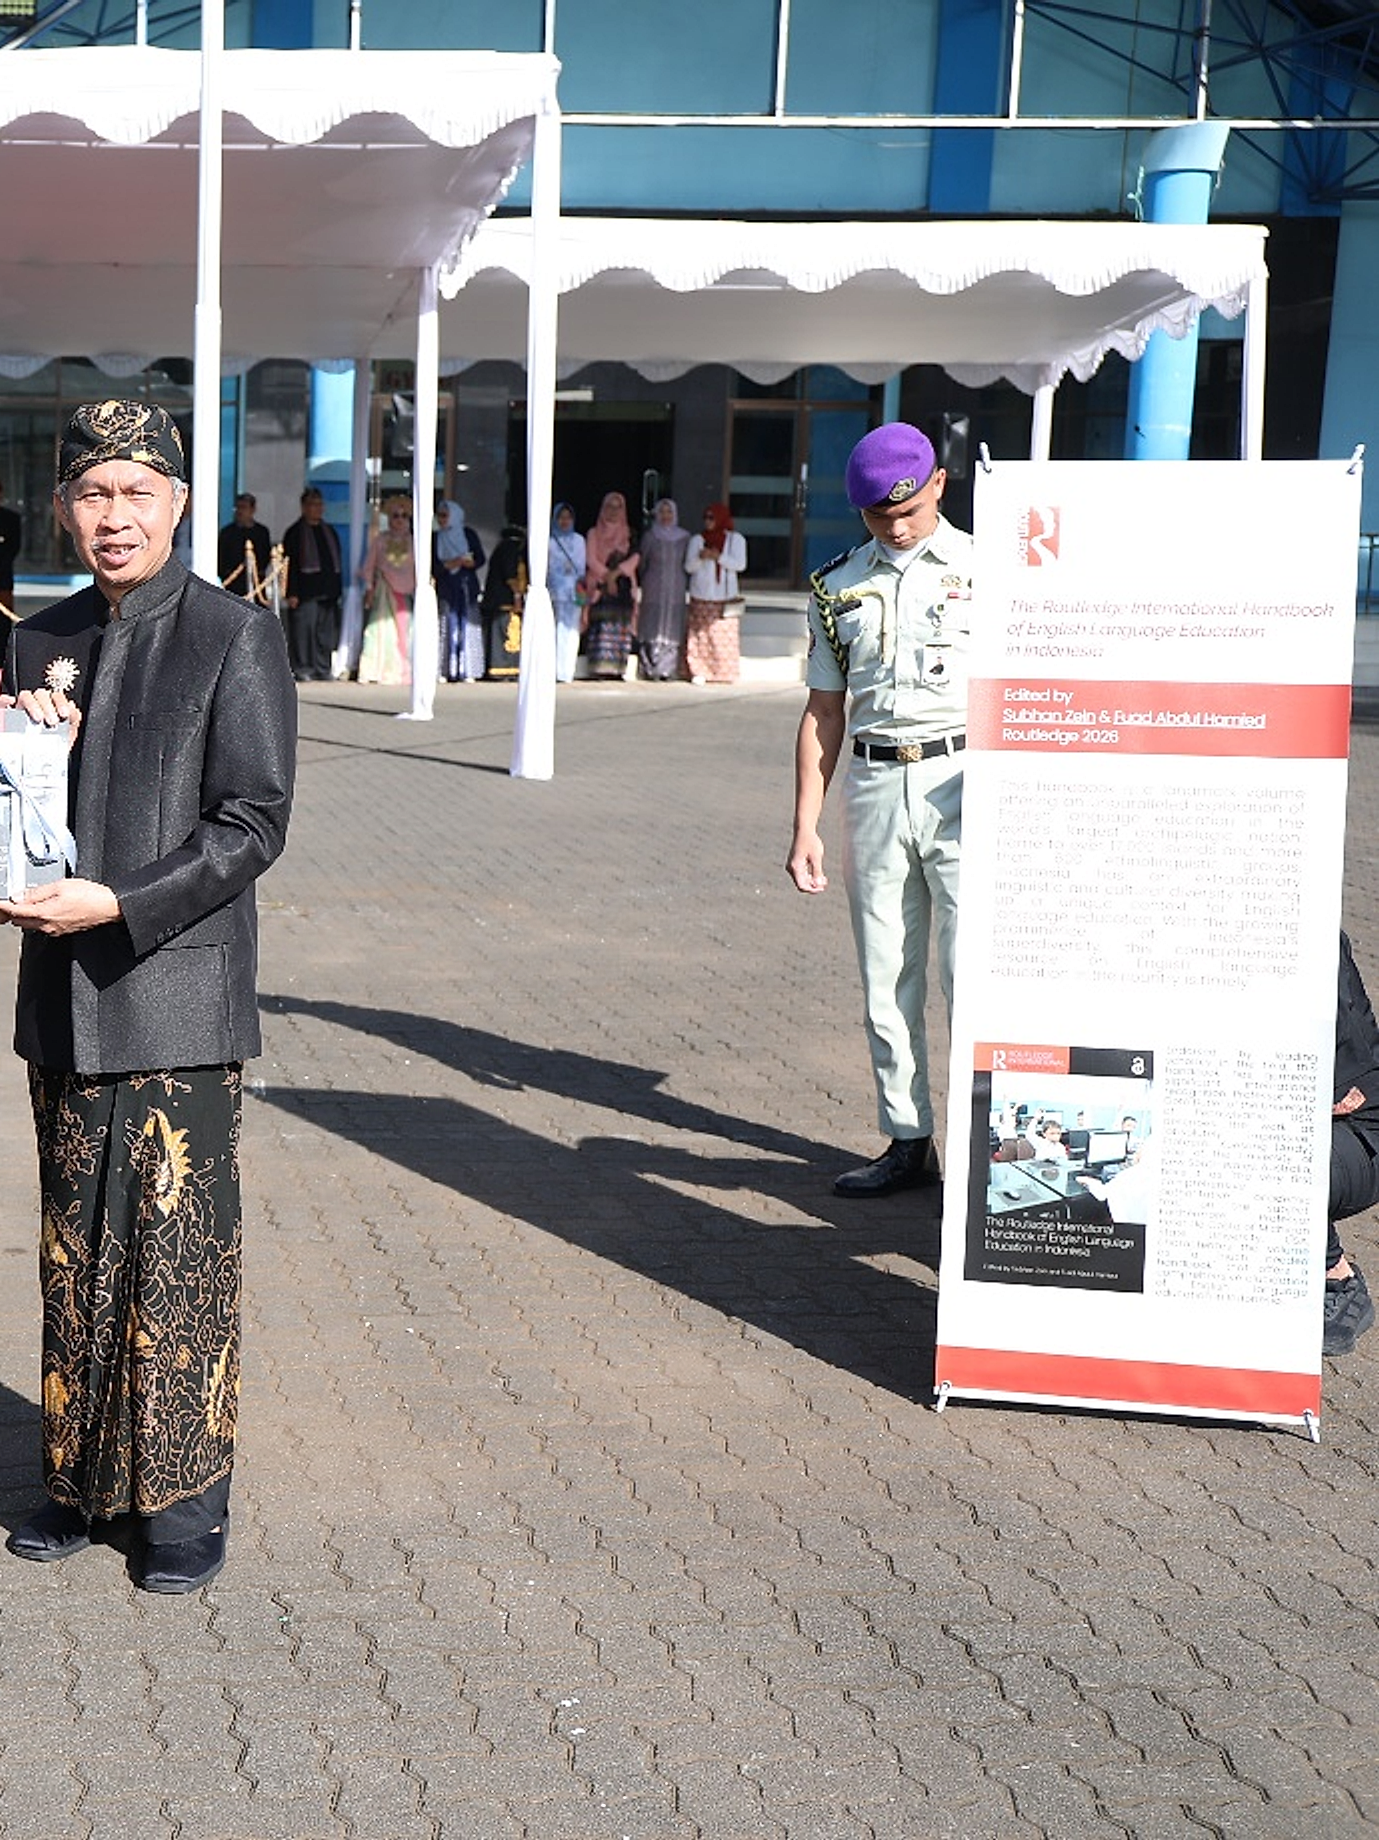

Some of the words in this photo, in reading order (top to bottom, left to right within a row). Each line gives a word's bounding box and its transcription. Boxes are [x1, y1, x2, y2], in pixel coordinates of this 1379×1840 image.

[1011, 600, 1038, 614] The
[1042, 601, 1128, 618] Routledge
[1130, 602, 1238, 617] International
[1242, 602, 1334, 618] Handbook
[1006, 620, 1024, 638] of
[1026, 621, 1087, 639] English
[1089, 622, 1175, 640] Language
[1179, 624, 1265, 638] Education
[1006, 642, 1021, 657] in
[1023, 643, 1104, 658] Indonesia
[1004, 688, 1050, 701] Edited
[1053, 689, 1074, 706] by
[1002, 708, 1061, 724] Subhan
[1065, 710, 1096, 725] Zein
[1098, 711, 1111, 723] &
[1113, 710, 1152, 726] Fuad
[1155, 711, 1201, 727] Abdul
[1205, 712, 1266, 729] Hamied
[1003, 728, 1079, 745] Routledge
[1083, 730, 1119, 743] 2026
[986, 1216, 1004, 1227] The
[1007, 1218, 1055, 1231] Routledge
[1057, 1222, 1114, 1234] International
